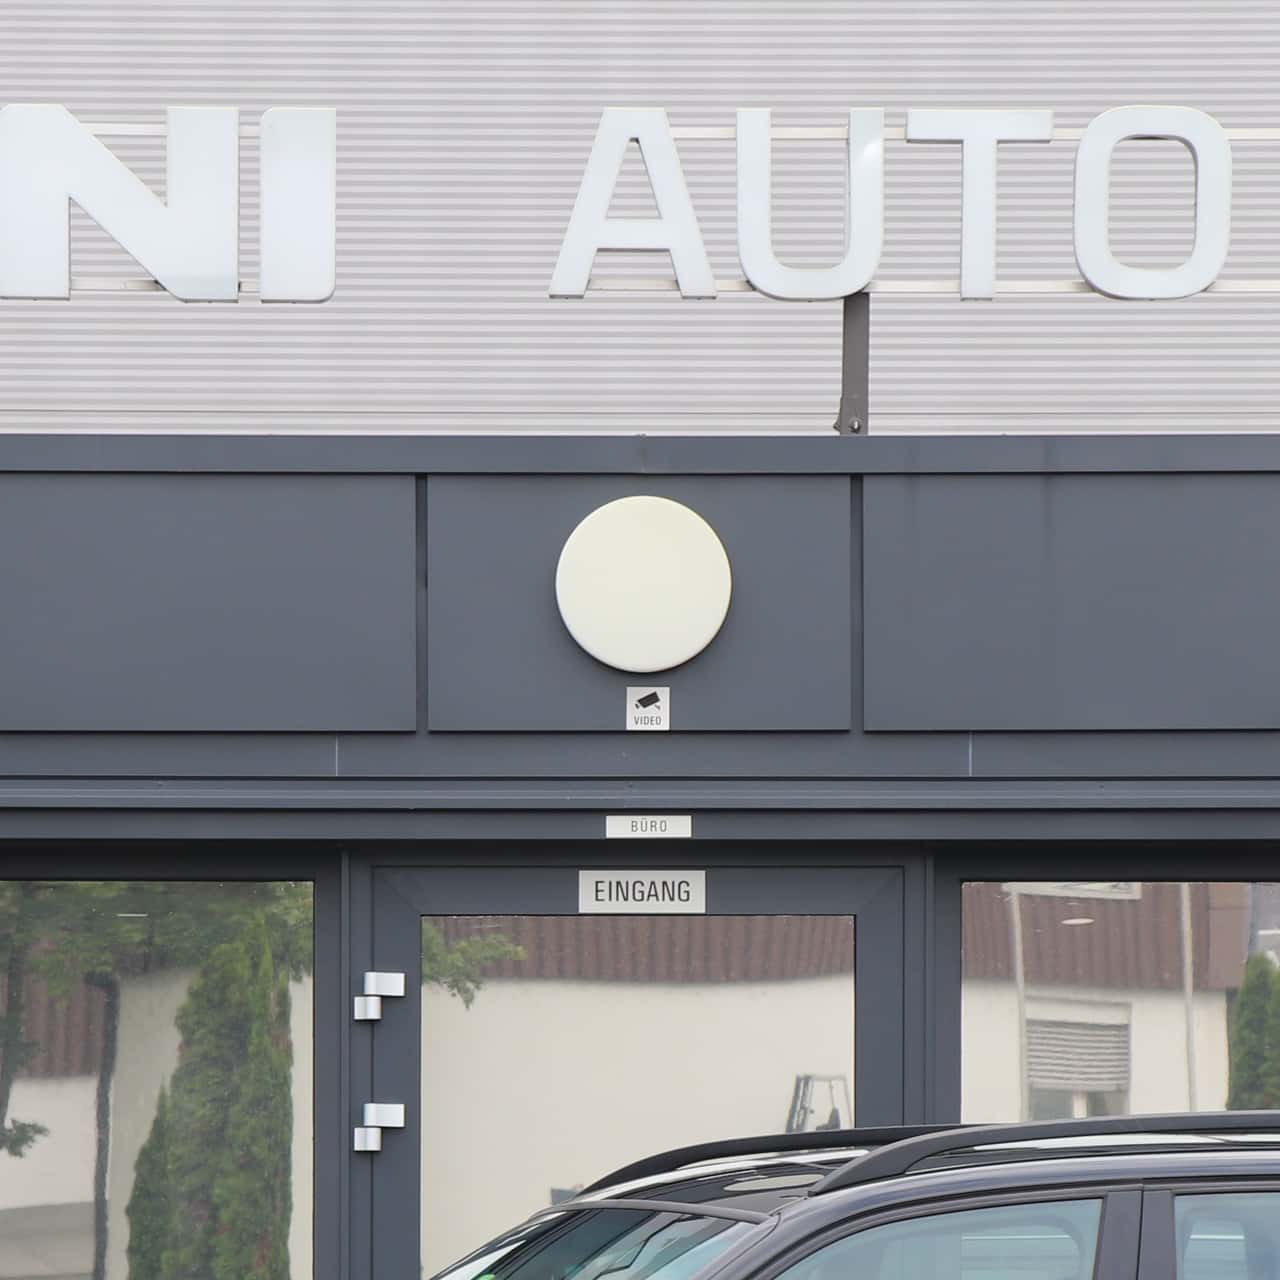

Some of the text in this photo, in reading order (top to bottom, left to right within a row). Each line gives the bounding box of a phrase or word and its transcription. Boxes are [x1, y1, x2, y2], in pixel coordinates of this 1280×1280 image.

[548, 105, 1233, 301] AUTO
[633, 715, 662, 727] VIDEO
[630, 817, 668, 833] BÜRO
[594, 880, 691, 902] EINGANG
